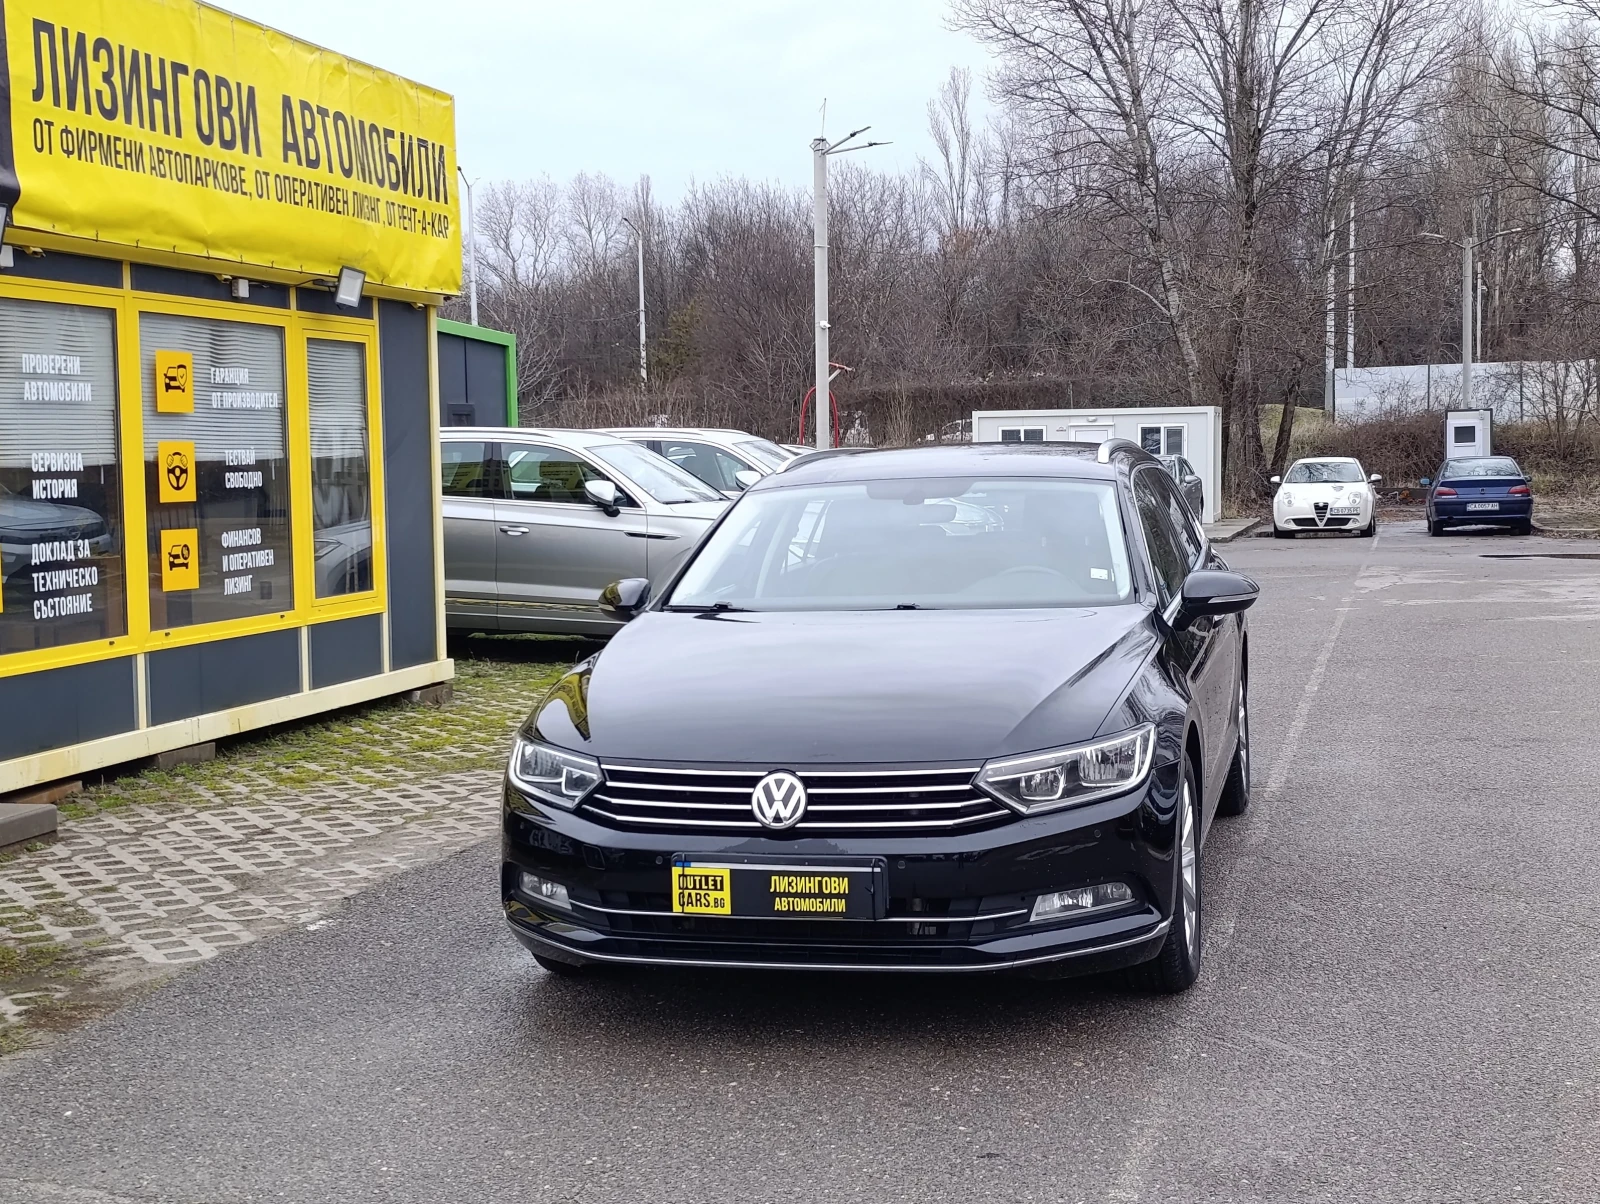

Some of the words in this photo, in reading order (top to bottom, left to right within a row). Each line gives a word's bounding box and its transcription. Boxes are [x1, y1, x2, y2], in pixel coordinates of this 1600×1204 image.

[32, 17, 262, 157] ЛИЗИНГОВИ
[281, 94, 449, 205] АВТОМОБИЛИ
[33, 118, 54, 155] ОТ
[60, 125, 146, 174] ФИРМЕНИ
[149, 145, 252, 202] АВТОПАРКОВЕ,
[254, 169, 270, 200] ОТ
[274, 173, 349, 216] ОПЕРАТИВЕН
[386, 200, 396, 228] ОТ
[397, 203, 449, 239] РЕНТ-А-КАР
[22, 353, 80, 375] ПРОВЕРЕНИ
[210, 368, 249, 386] ГАРАНЦИЯ
[24, 381, 92, 401] АВТОМОБИЛИ
[212, 392, 221, 408] ОТ
[223, 392, 278, 410] ПРОИЗВОДИТЕЛ
[31, 452, 83, 472] СЕРВИЗНА
[224, 447, 256, 466] ТЕСТВАЙ
[32, 478, 78, 500] ИСТОРИЯ
[225, 471, 263, 489] СВОБОДНО
[221, 527, 262, 548] ФИНАНСОВ
[31, 540, 75, 566] ДОКЛАД
[77, 539, 91, 559] ЗА
[222, 555, 228, 572] И
[229, 549, 274, 571] ОПЕРАТИВЕН
[32, 566, 98, 592] ТЕХНИЧЕСКО
[224, 575, 253, 595] ЛИЗИНГ
[33, 593, 93, 620] СЪСТОЯНИЕ
[679, 875, 722, 890] OUTLET
[769, 875, 849, 894] ЛИЗИНГОВИ
[678, 891, 725, 909] CARS.BG
[774, 897, 846, 912] АВТОМОБИЛИ
